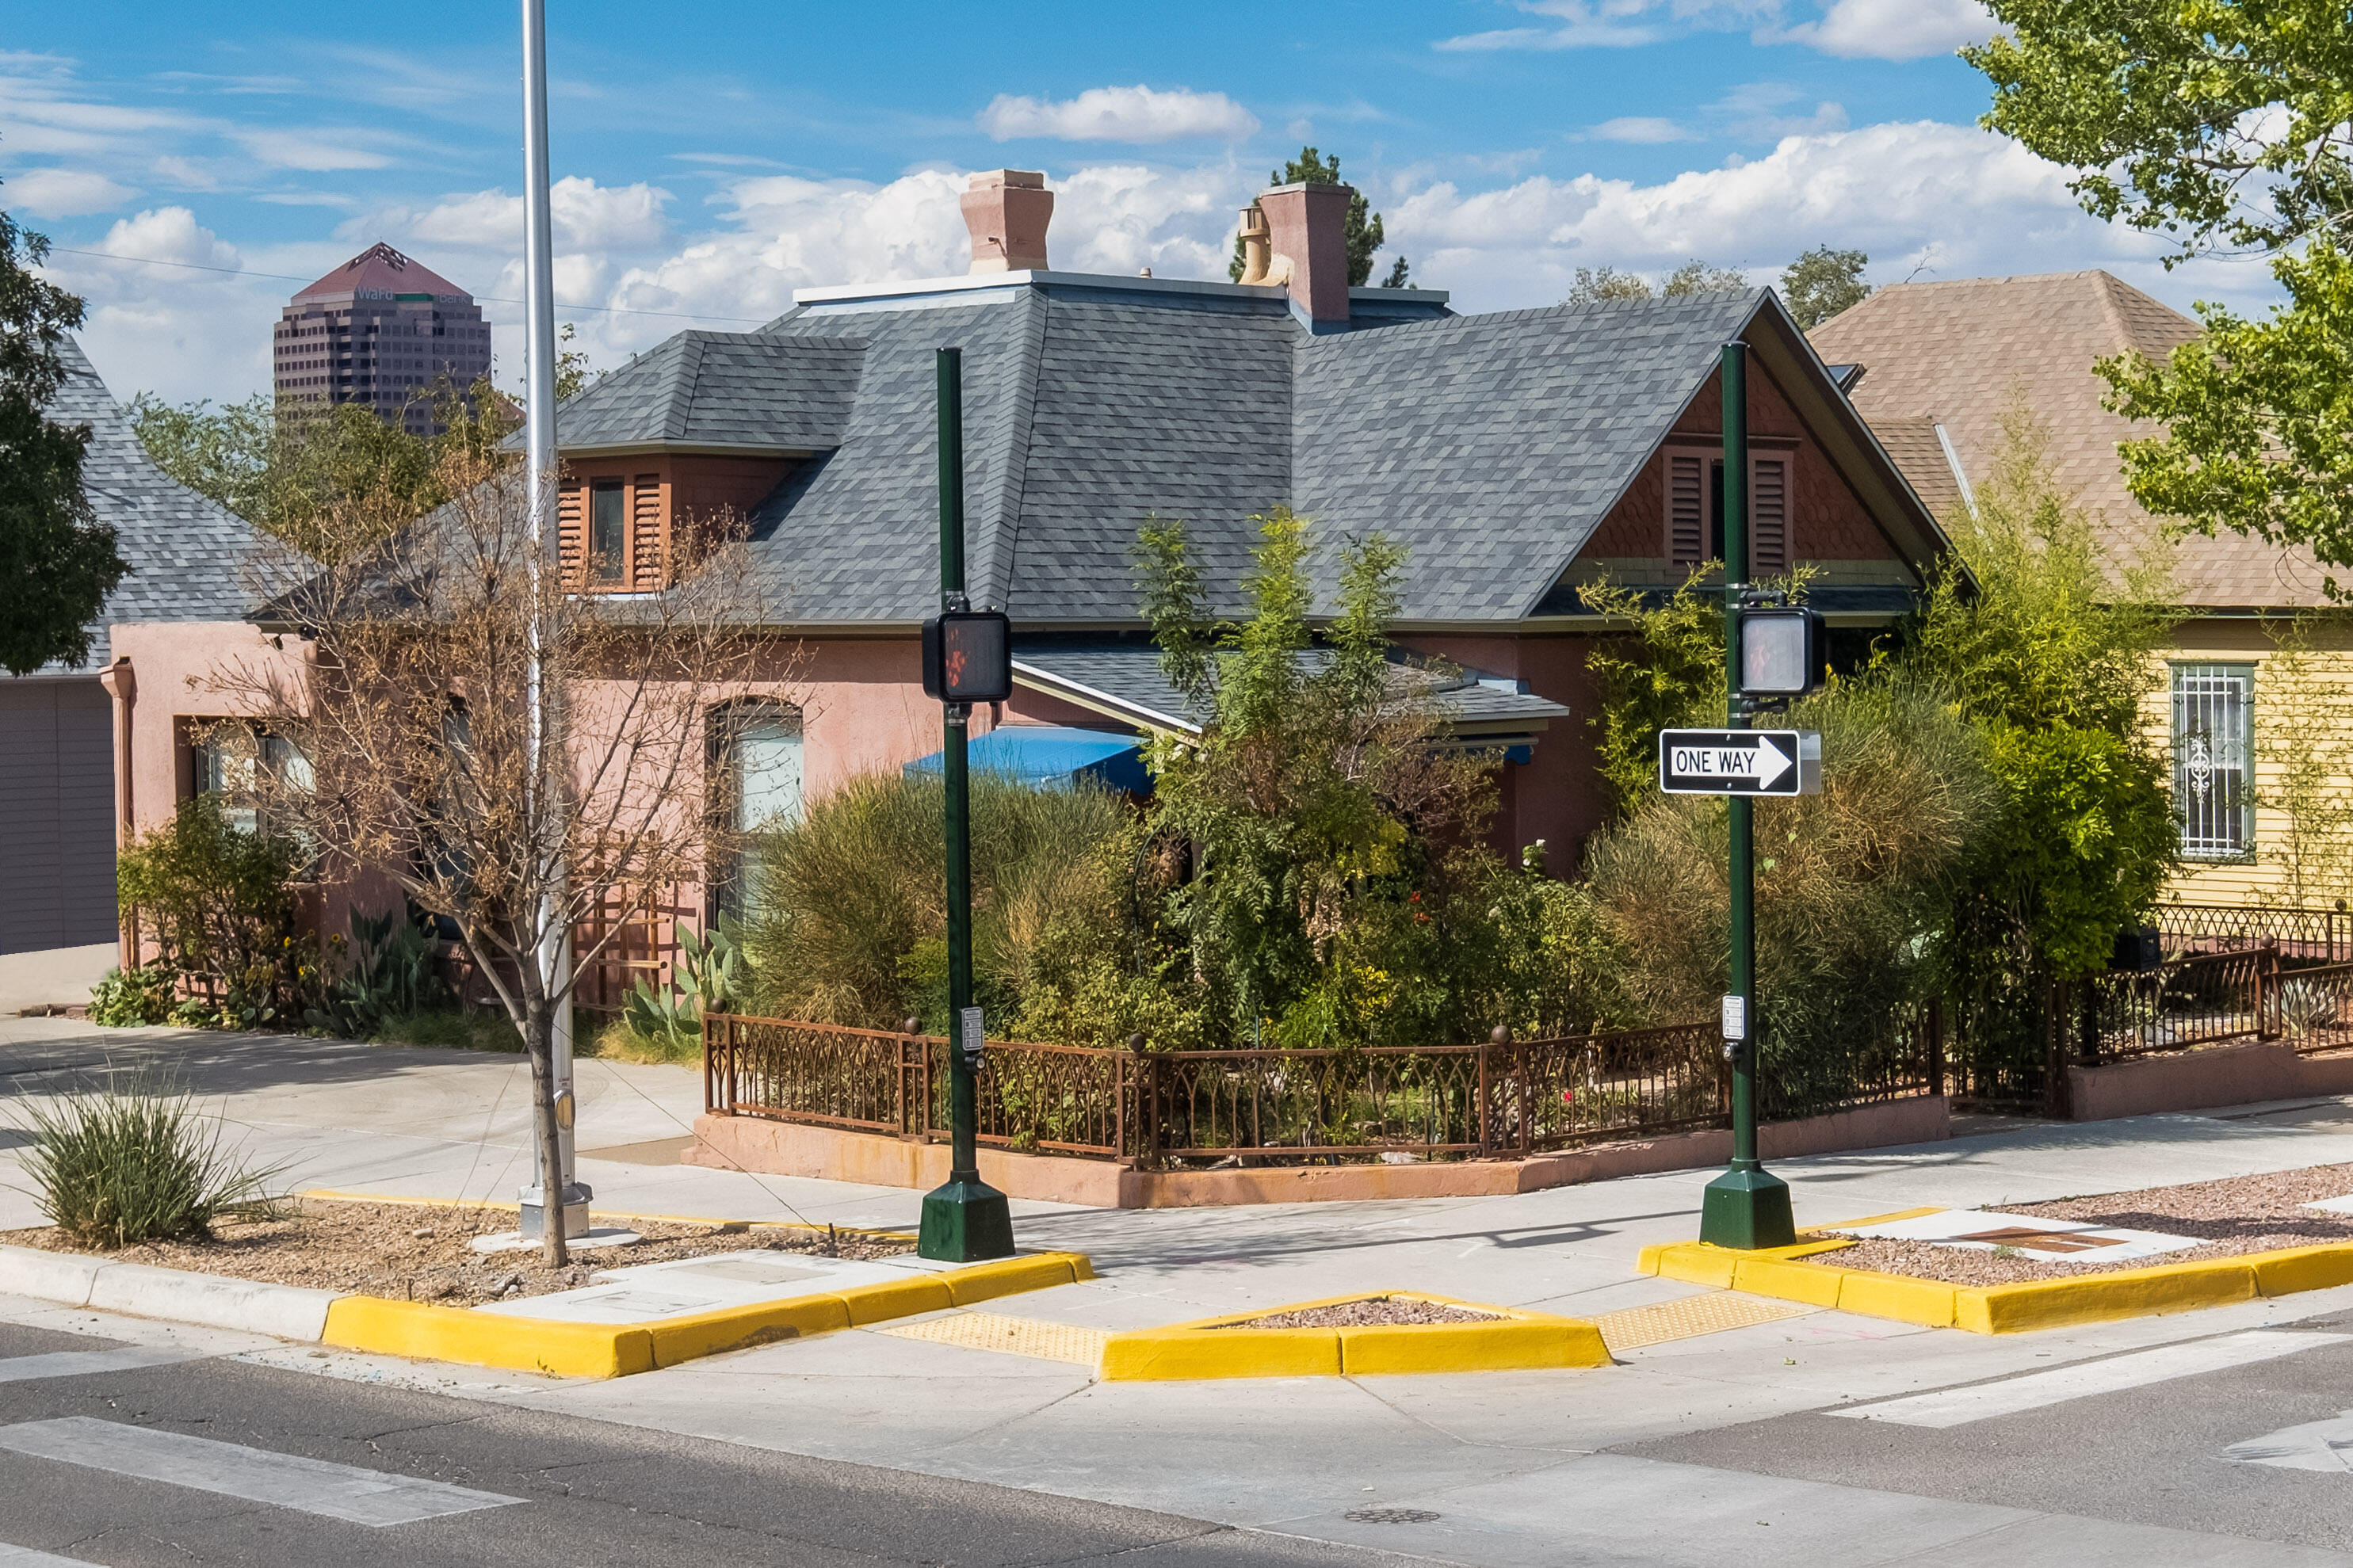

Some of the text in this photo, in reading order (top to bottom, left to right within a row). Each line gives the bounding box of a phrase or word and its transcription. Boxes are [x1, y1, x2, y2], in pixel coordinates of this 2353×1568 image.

[438, 292, 469, 303] Bank
[1676, 750, 1756, 774] ONE WAY
